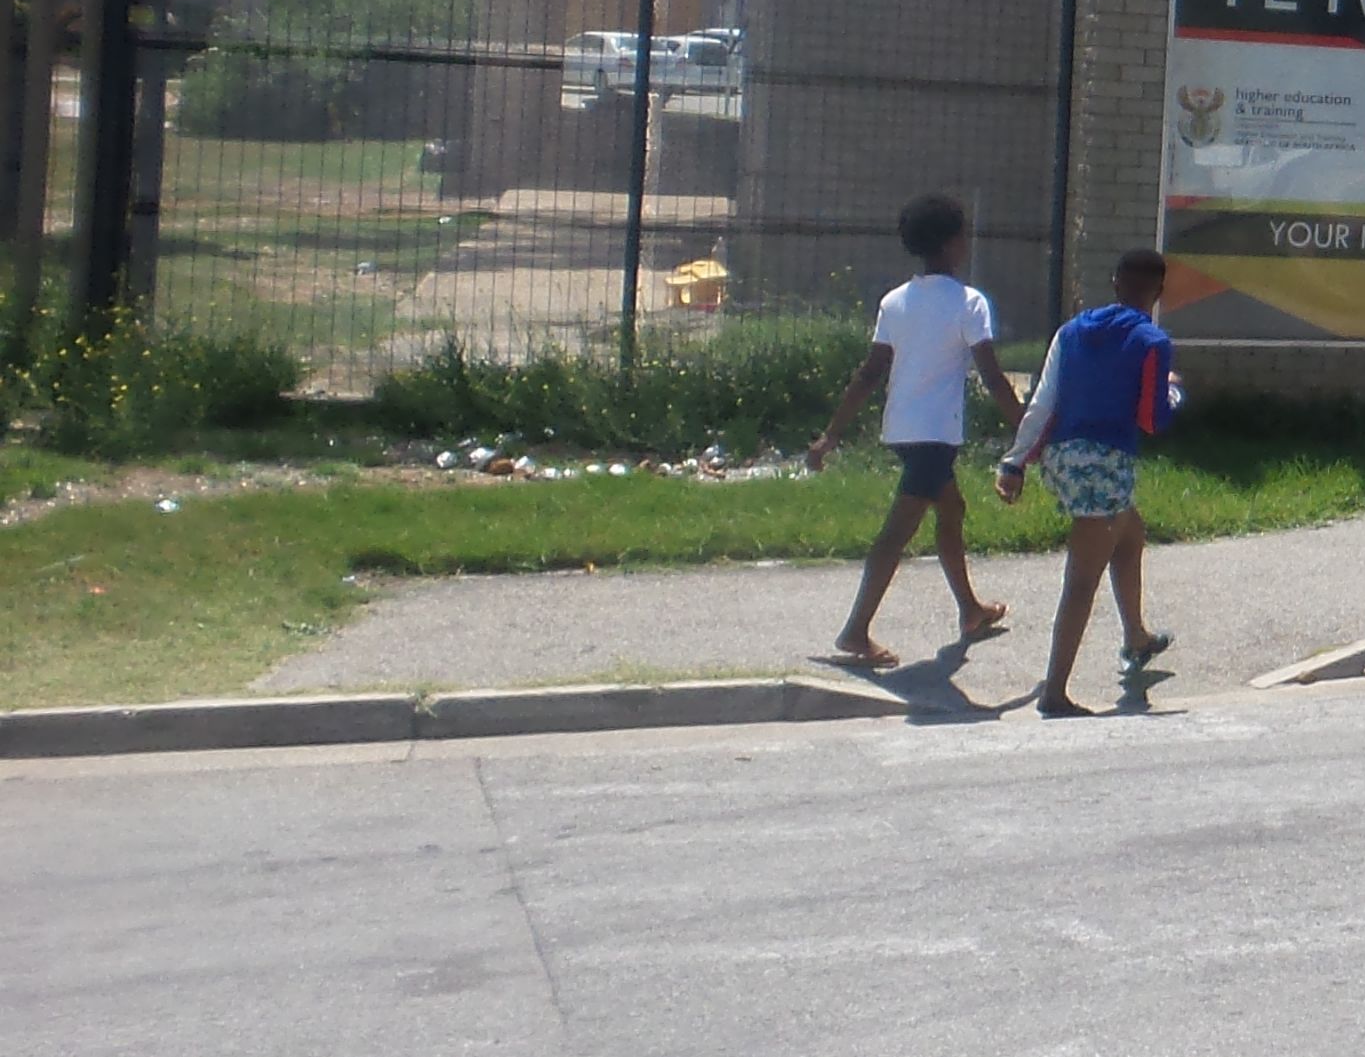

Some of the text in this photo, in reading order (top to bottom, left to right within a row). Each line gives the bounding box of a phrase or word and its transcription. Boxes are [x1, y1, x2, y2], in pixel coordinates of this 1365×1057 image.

[1235, 87, 1352, 106] higher education
[1251, 104, 1304, 122] training
[1269, 219, 1350, 250] YOUR
